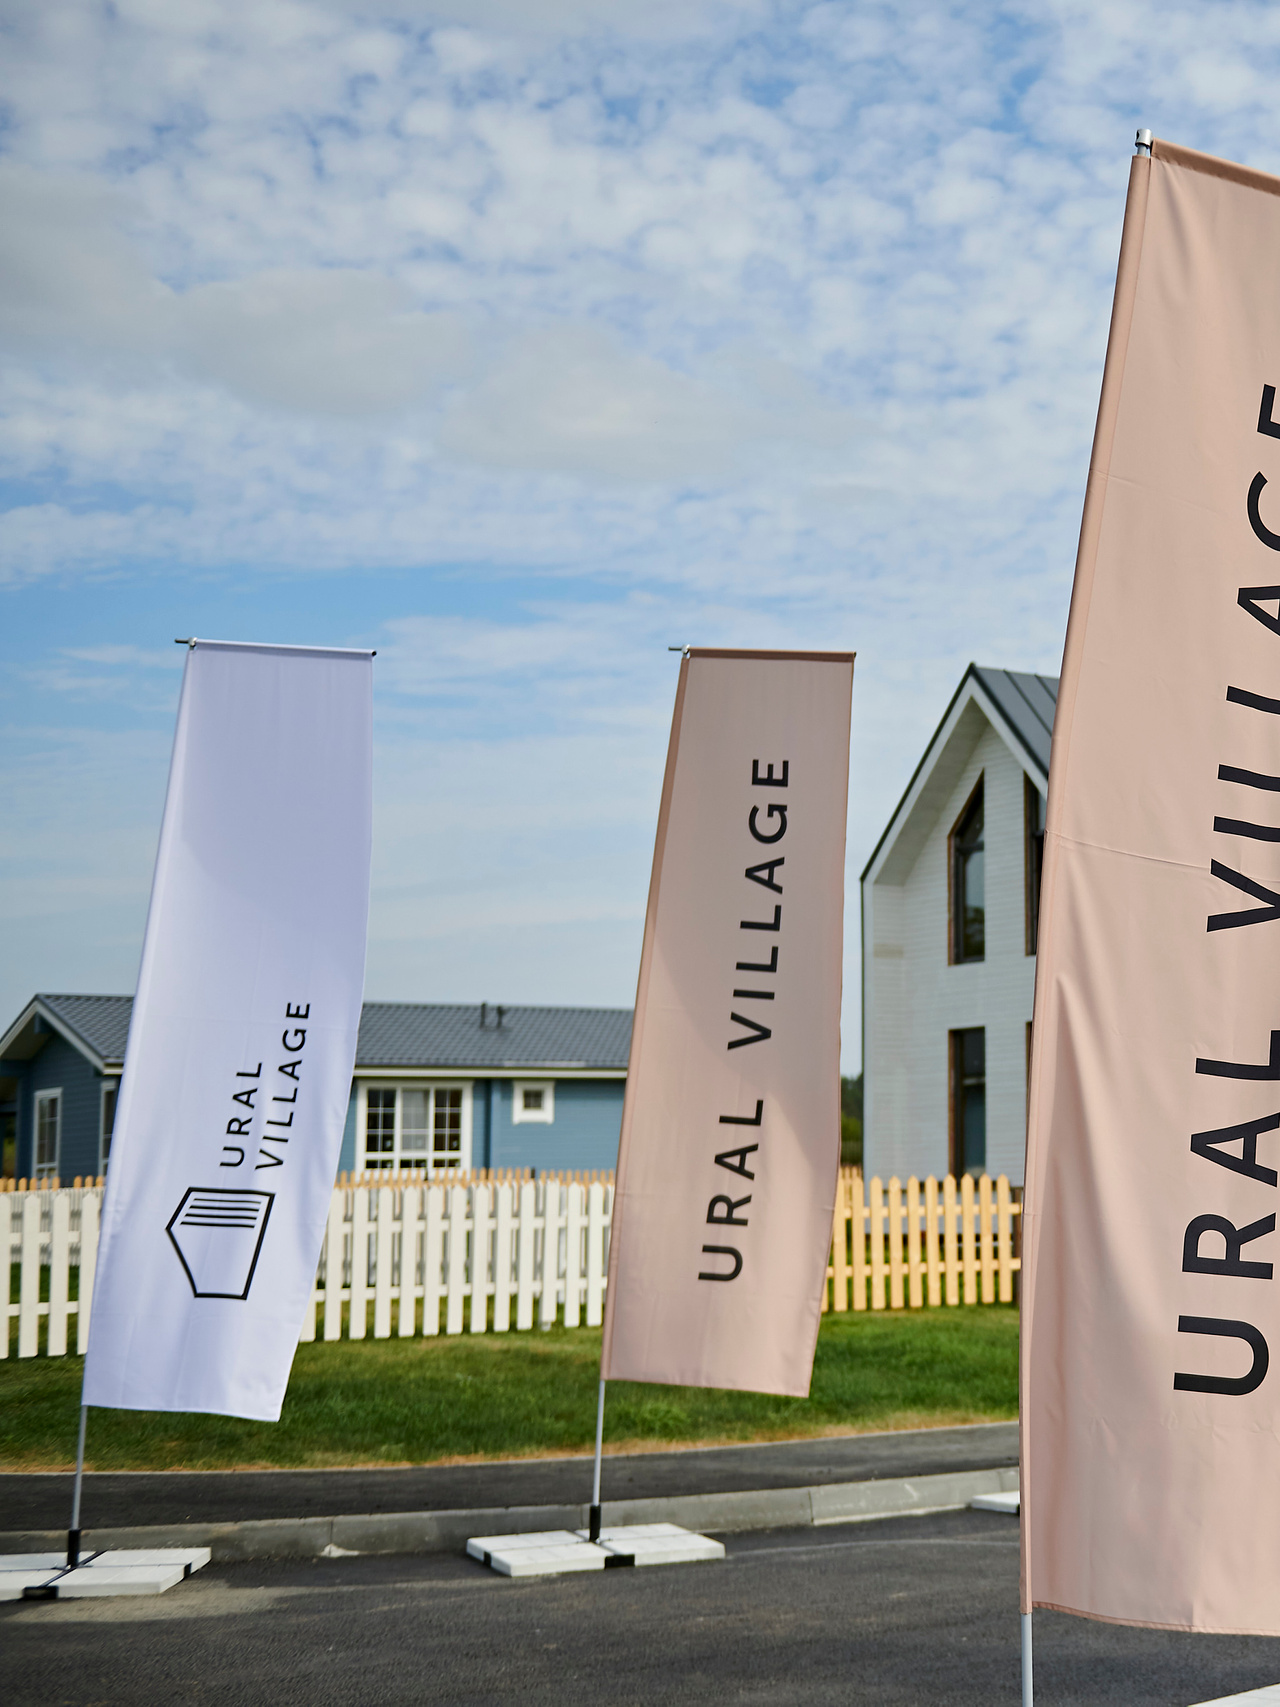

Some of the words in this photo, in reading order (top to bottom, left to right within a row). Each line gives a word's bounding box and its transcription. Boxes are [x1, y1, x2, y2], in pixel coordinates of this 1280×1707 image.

[725, 757, 791, 1052] VILLAGE
[218, 1060, 263, 1169] URAL
[253, 1001, 312, 1171] VILLAGE
[696, 1098, 765, 1283] URAL
